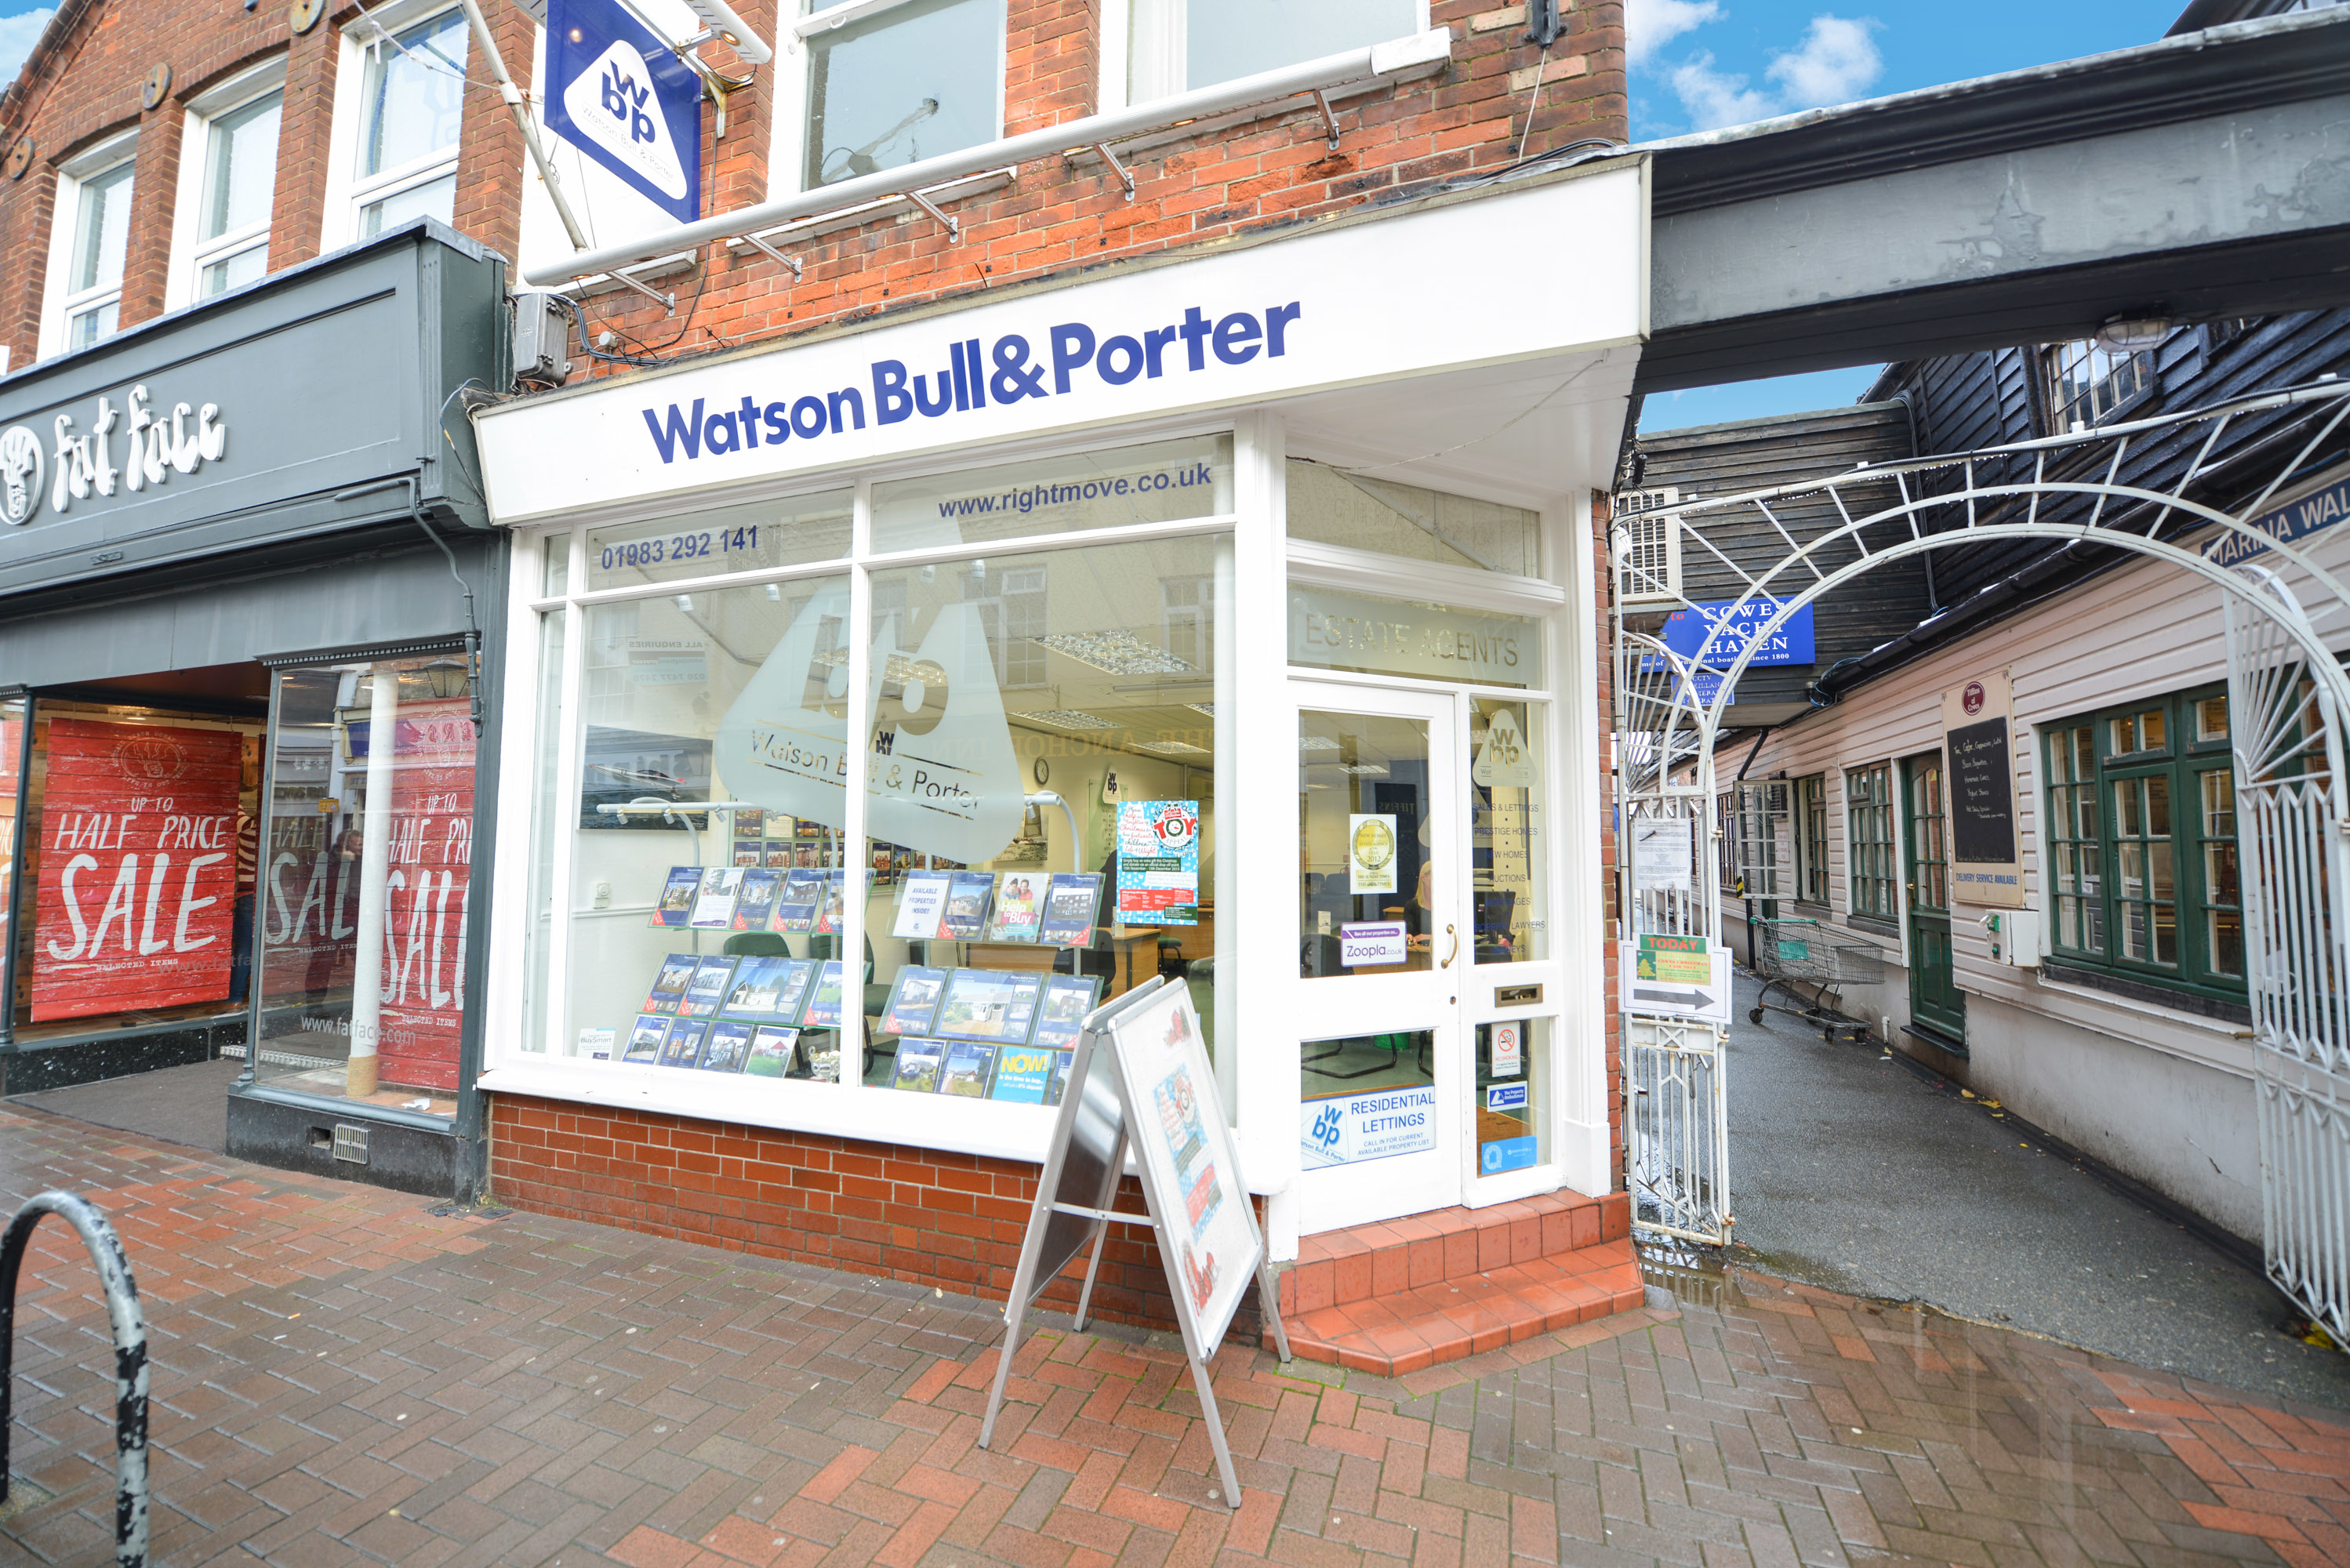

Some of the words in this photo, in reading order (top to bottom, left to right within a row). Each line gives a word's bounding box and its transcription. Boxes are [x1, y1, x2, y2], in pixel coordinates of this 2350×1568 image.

[641, 387, 866, 464] Watson
[939, 463, 1211, 517] www.rightmove.co.uk
[601, 539, 663, 570] 01983
[671, 532, 710, 561] 292
[720, 524, 757, 553] 141
[2207, 513, 2293, 564] MARINA
[1306, 614, 1411, 655] ESTATE
[1418, 627, 1519, 667] AGENTS
[1967, 687, 1981, 697] Tiffins
[751, 729, 828, 771] Watson
[837, 751, 880, 782] Bll
[886, 764, 903, 789] &
[912, 770, 985, 810] Porter
[132, 797, 147, 812] UP
[156, 797, 173, 812] TO
[427, 796, 439, 815] UP
[442, 793, 457, 813] TO
[1473, 803, 1496, 811] SALES
[1505, 804, 1539, 812] LETTINGS
[53, 813, 137, 850] HALF
[157, 815, 231, 849] PRICE
[1153, 818, 1197, 840] TOY
[444, 818, 473, 865] PRI
[1489, 874, 1526, 883] AUCTIONS
[1956, 873, 1975, 883] DELIVERY
[1976, 873, 1993, 884] SERVICE
[1995, 874, 2018, 885] AVAILABLE
[47, 852, 227, 960] SALE
[266, 851, 355, 945] SAL
[1001, 901, 1026, 913] Help
[1009, 913, 1031, 927] Buy
[1511, 920, 1545, 930] LAWYERS
[1647, 937, 1698, 950] TODAY
[96, 961, 145, 971] SELECTED
[150, 958, 179, 967] ITEMS
[301, 1016, 416, 1047] www.fatface.com
[401, 1014, 434, 1026] SELECTED
[436, 1018, 457, 1027] ITEMS
[1001, 1054, 1049, 1074] NOW!
[1351, 1092, 1436, 1116] RESIDENTIAL
[1363, 1112, 1425, 1134] LETTINGS
[1399, 1132, 1424, 1142] CURRENT
[1301, 1140, 1314, 1150] atson
[1315, 1145, 1324, 1154] Bull
[1331, 1152, 1346, 1163] Porter
[1357, 1146, 1387, 1156] AVAILABLE
[1389, 1142, 1418, 1151] PROPERTY
